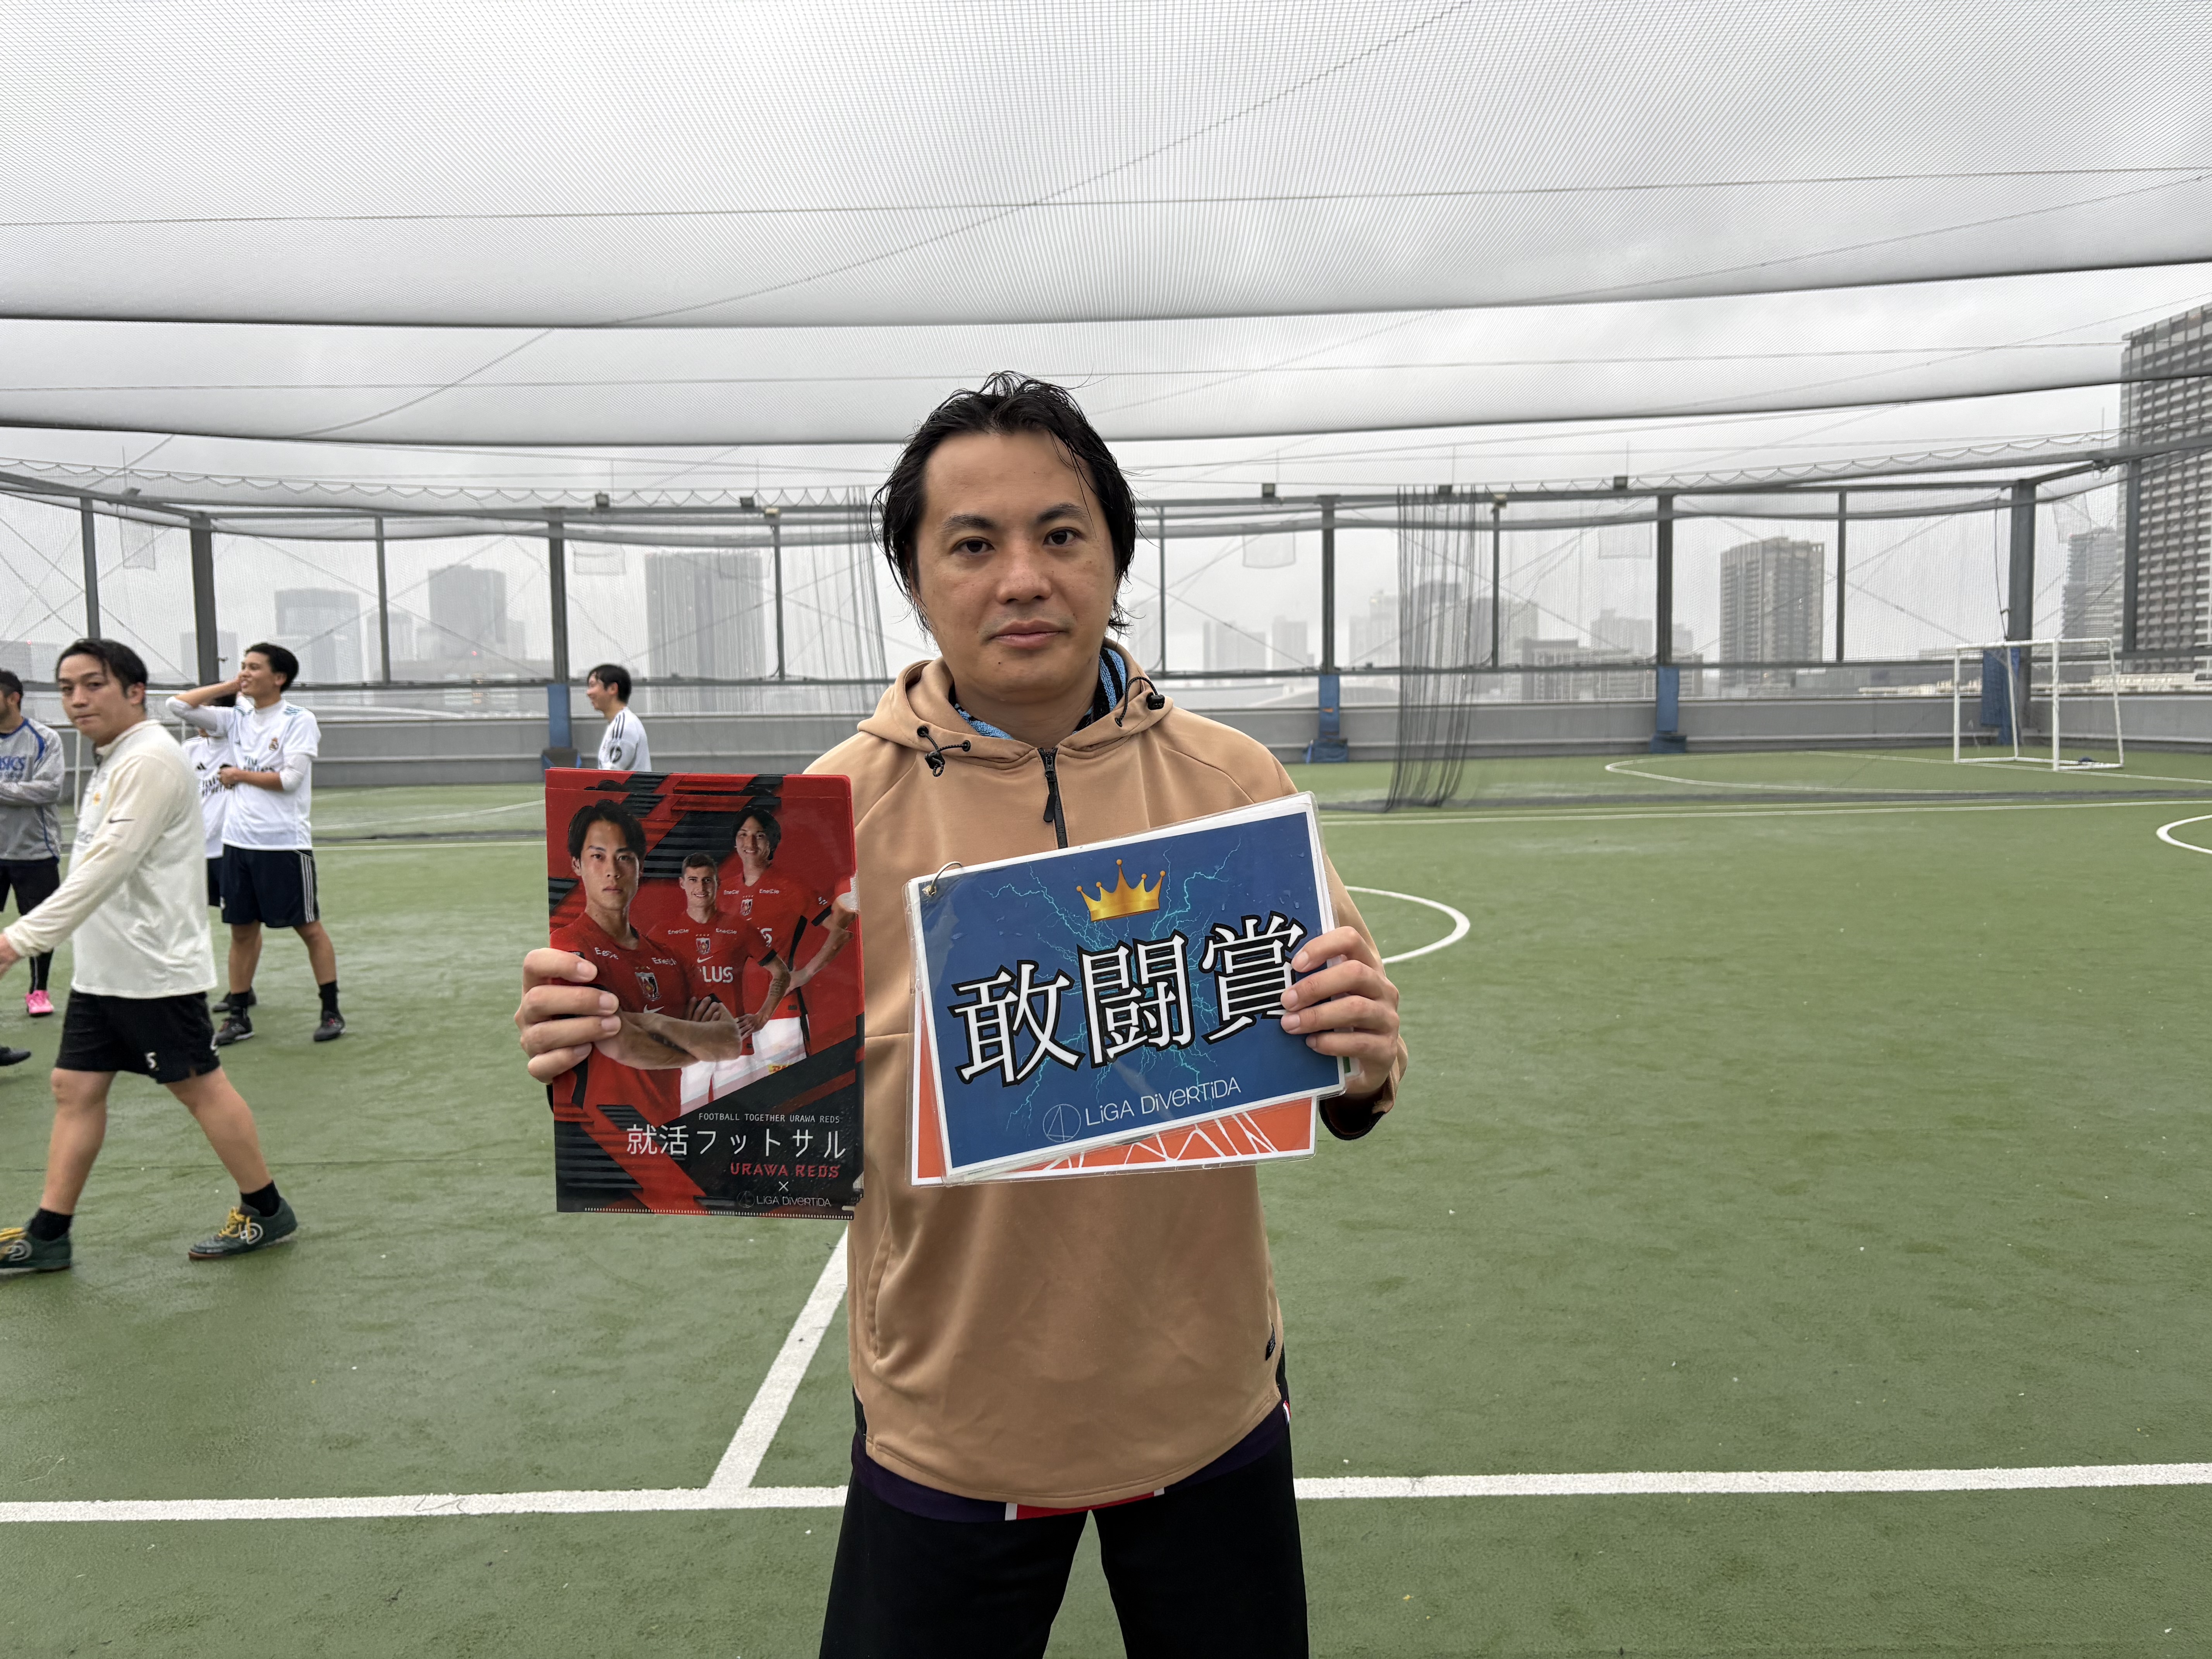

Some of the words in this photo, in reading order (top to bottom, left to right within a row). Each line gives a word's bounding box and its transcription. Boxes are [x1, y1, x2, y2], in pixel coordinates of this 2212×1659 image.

[699, 966, 733, 983] LUS
[950, 912, 1307, 1086] 敢闘賞
[699, 1113, 740, 1121] FOOTBALL
[745, 1114, 785, 1122] TOGETHER
[790, 1115, 816, 1123] URAWA
[626, 1123, 846, 1159] 就活フットサル
[730, 1162, 789, 1177] URAWA
[795, 1164, 842, 1178] REDS
